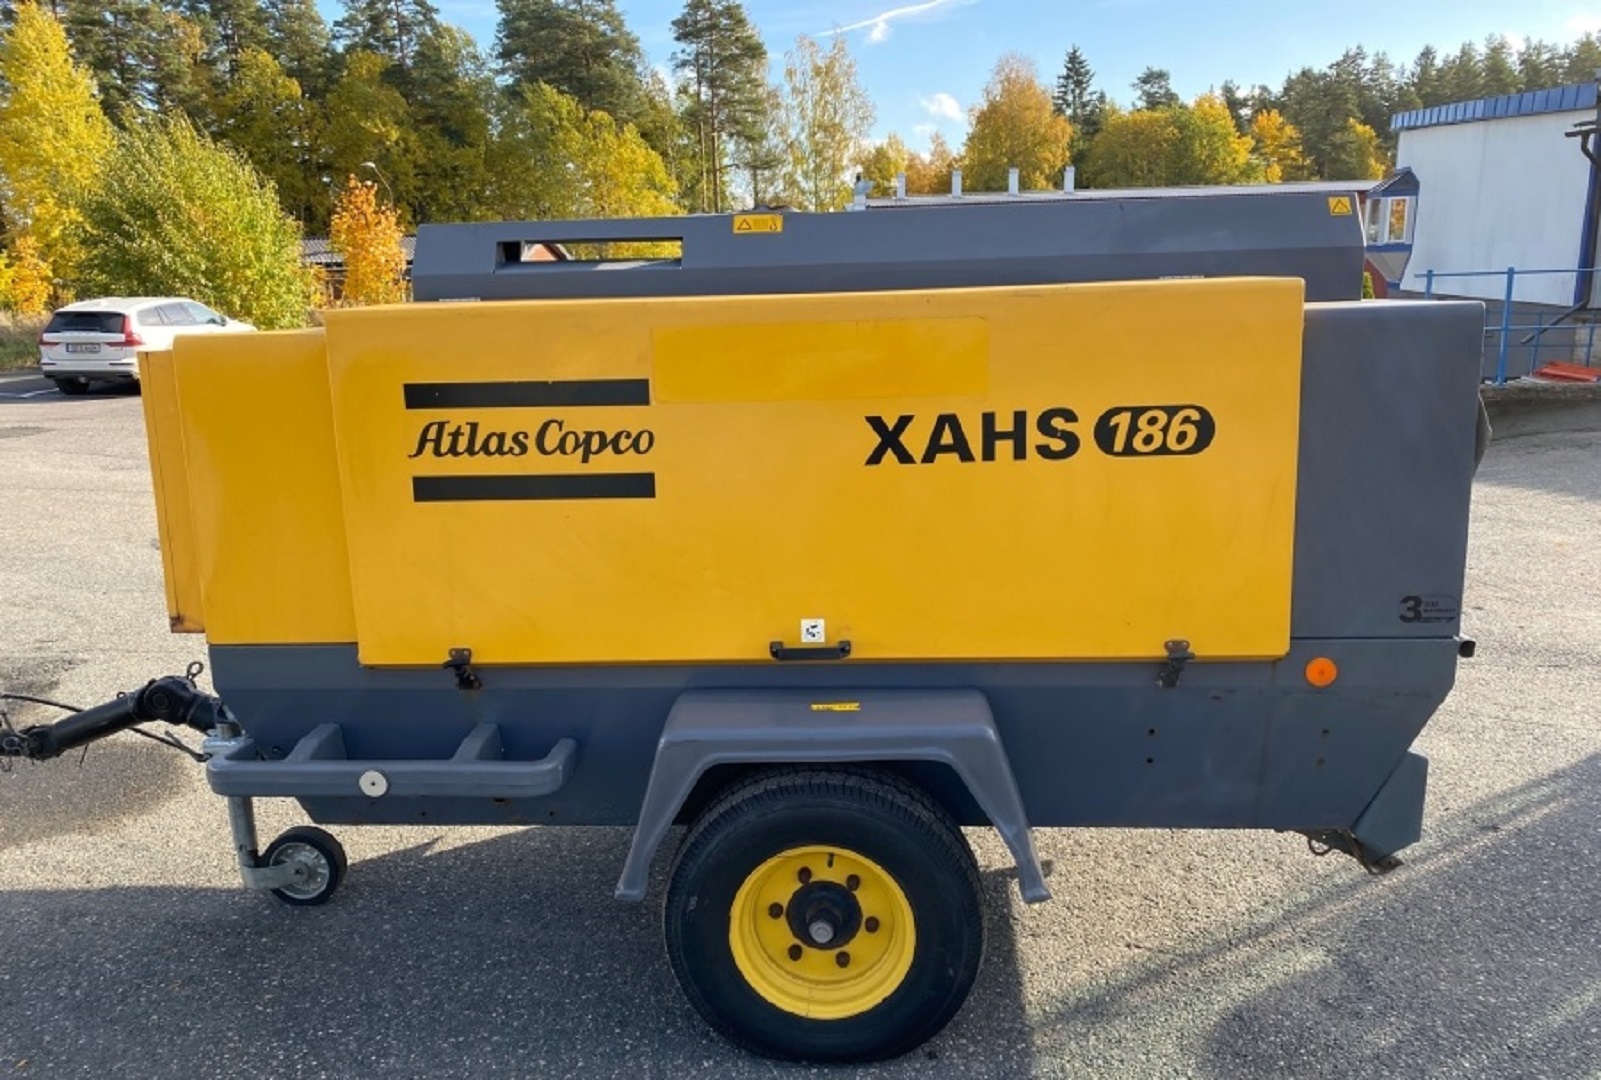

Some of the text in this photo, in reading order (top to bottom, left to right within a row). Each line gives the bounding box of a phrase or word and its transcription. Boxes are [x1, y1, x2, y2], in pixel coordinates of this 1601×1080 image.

[409, 419, 655, 464] Atlas Copco
[865, 407, 1201, 466] XAHS 186
[1399, 595, 1422, 624] 3
